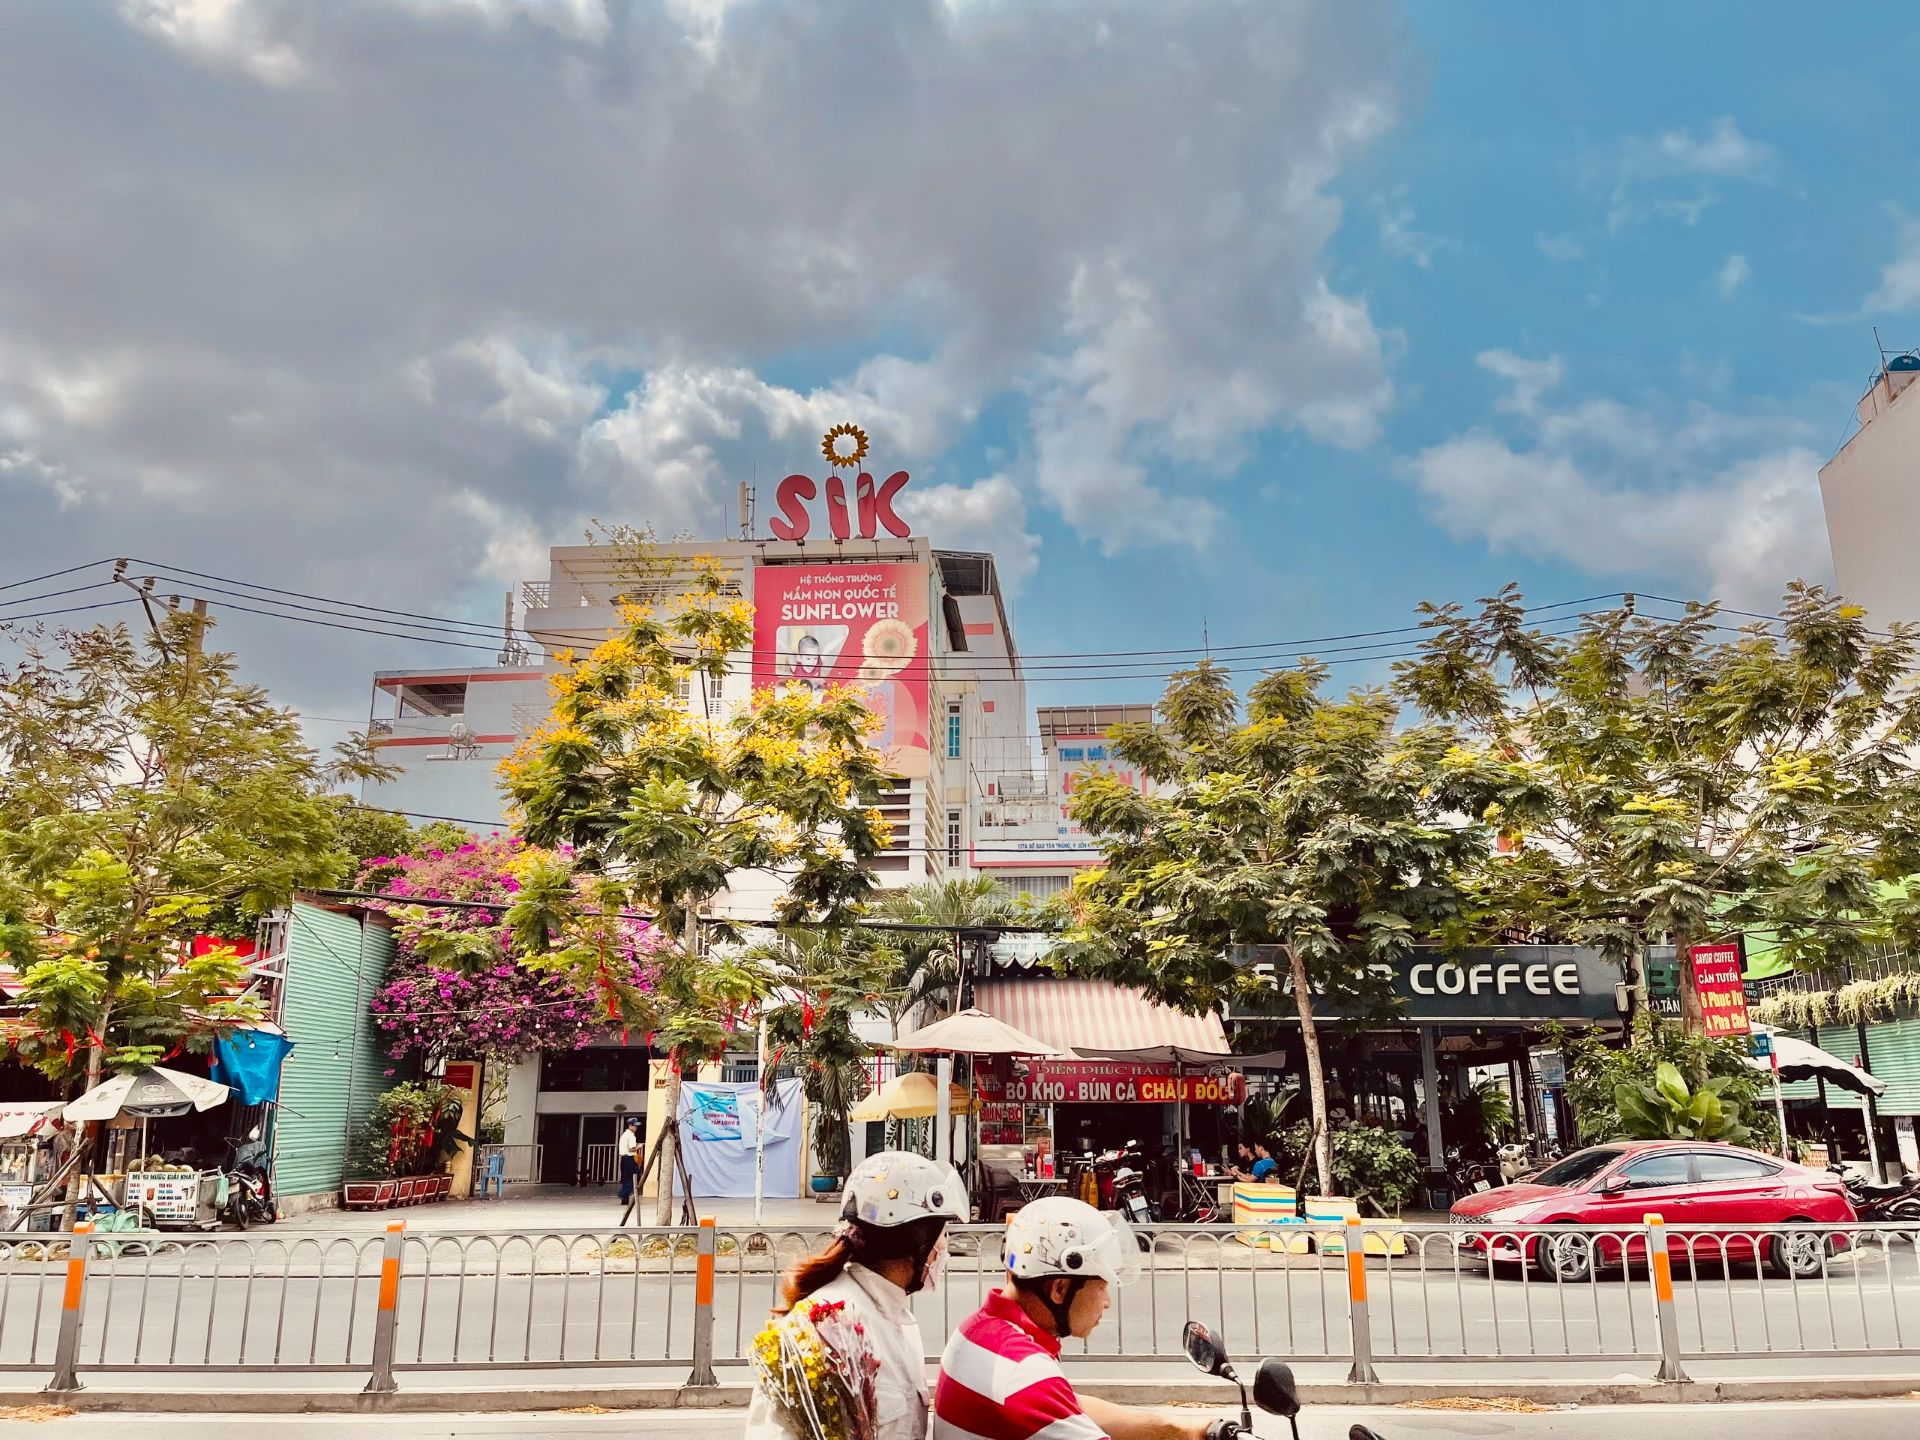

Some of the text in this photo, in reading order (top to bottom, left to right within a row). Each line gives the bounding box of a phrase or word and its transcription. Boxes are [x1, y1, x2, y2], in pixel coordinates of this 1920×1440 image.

[814, 589, 841, 600] NON
[844, 584, 880, 600] QUỐC
[882, 583, 897, 598] TẾ
[780, 602, 899, 621] SUNFLOWER
[1696, 952, 1734, 964] SAVOR COFFEE
[1410, 964, 1580, 995] COFFEE
[1700, 992, 1708, 1008] 6
[1708, 990, 1732, 1010] Phục
[1706, 1016, 1712, 1031] 4
[1712, 1014, 1730, 1030] Pha
[1006, 1078, 1027, 1100] BÒ
[1032, 1082, 1065, 1100] KHO
[1078, 1078, 1111, 1100] BÚN
[1116, 1078, 1137, 1100] CÁ
[1142, 1079, 1188, 1100] CHÂU
